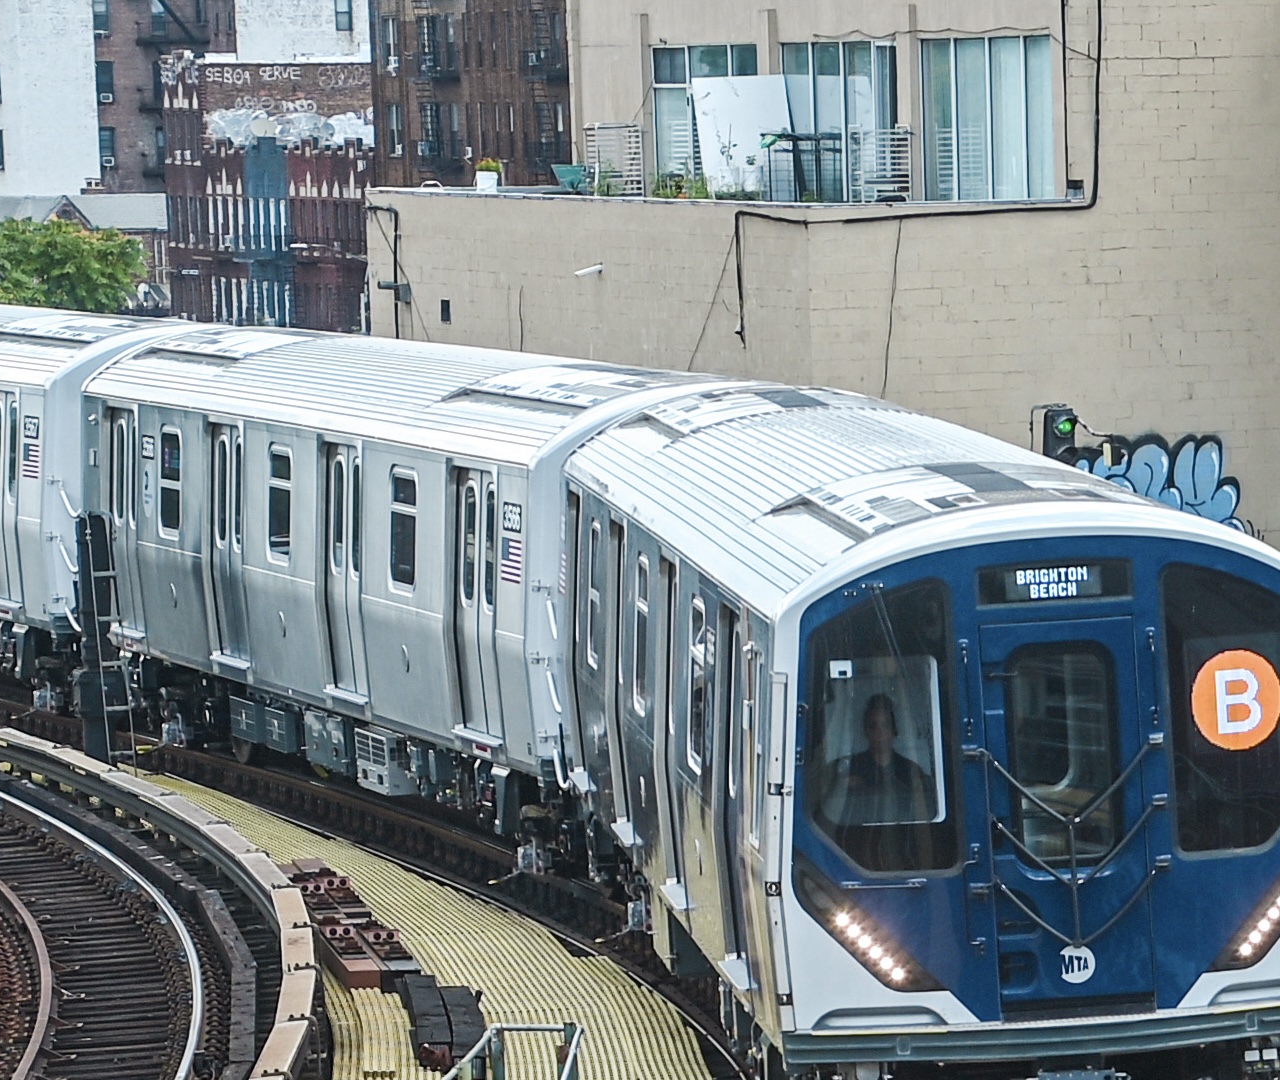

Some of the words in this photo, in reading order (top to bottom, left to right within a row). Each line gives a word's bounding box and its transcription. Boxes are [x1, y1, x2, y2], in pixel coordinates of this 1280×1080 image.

[1015, 566, 1088, 585] BRIGHTON
[1030, 582, 1077, 599] BEACH
[1214, 668, 1262, 735] B
[1061, 954, 1089, 975] MTA
